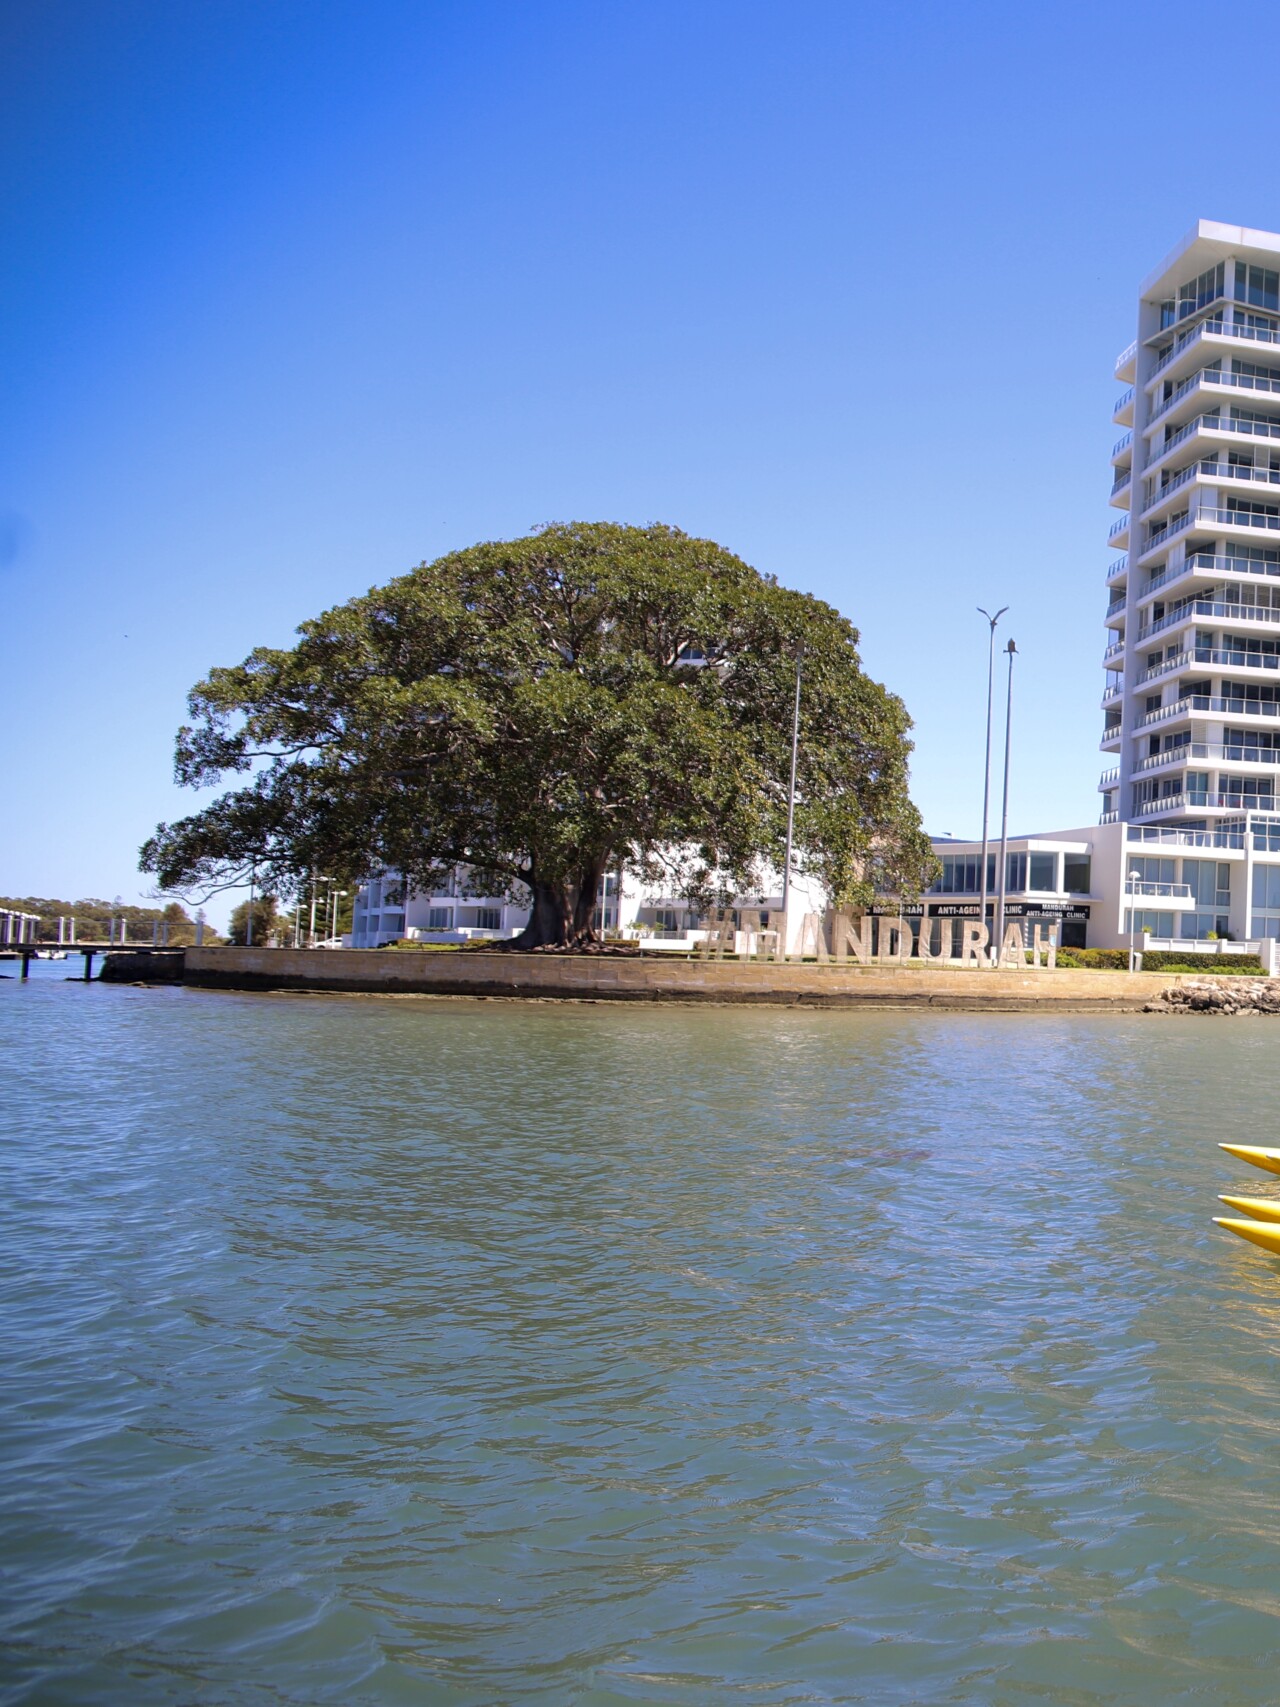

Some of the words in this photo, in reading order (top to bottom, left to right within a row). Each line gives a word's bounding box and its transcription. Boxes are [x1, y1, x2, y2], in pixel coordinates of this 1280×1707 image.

[873, 905, 923, 914] MARAH
[938, 906, 986, 915] ANTI-AGEIN
[1026, 910, 1063, 918] ANTI-AGEING
